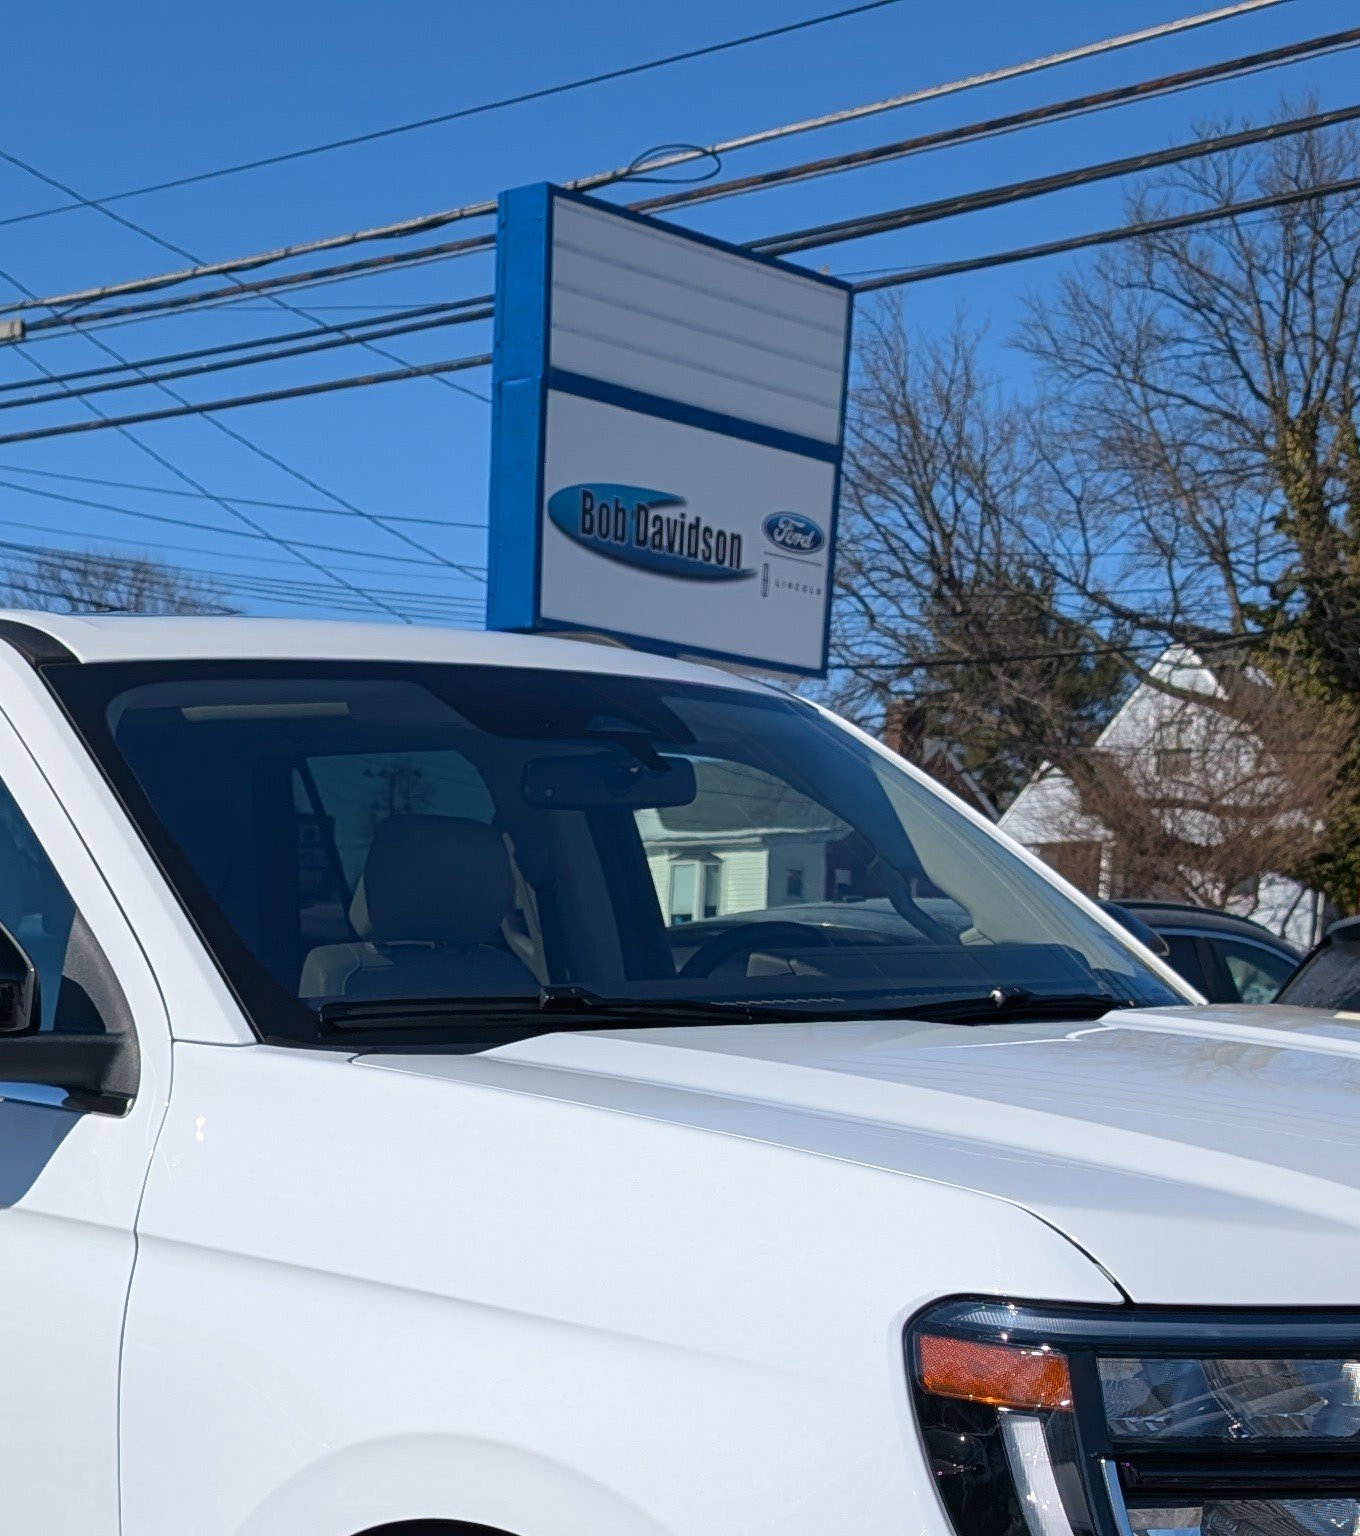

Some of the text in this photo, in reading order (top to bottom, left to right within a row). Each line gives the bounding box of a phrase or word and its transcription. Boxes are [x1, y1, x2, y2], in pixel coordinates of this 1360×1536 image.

[580, 488, 743, 570] Bob Davidson
[773, 517, 816, 550] Ford
